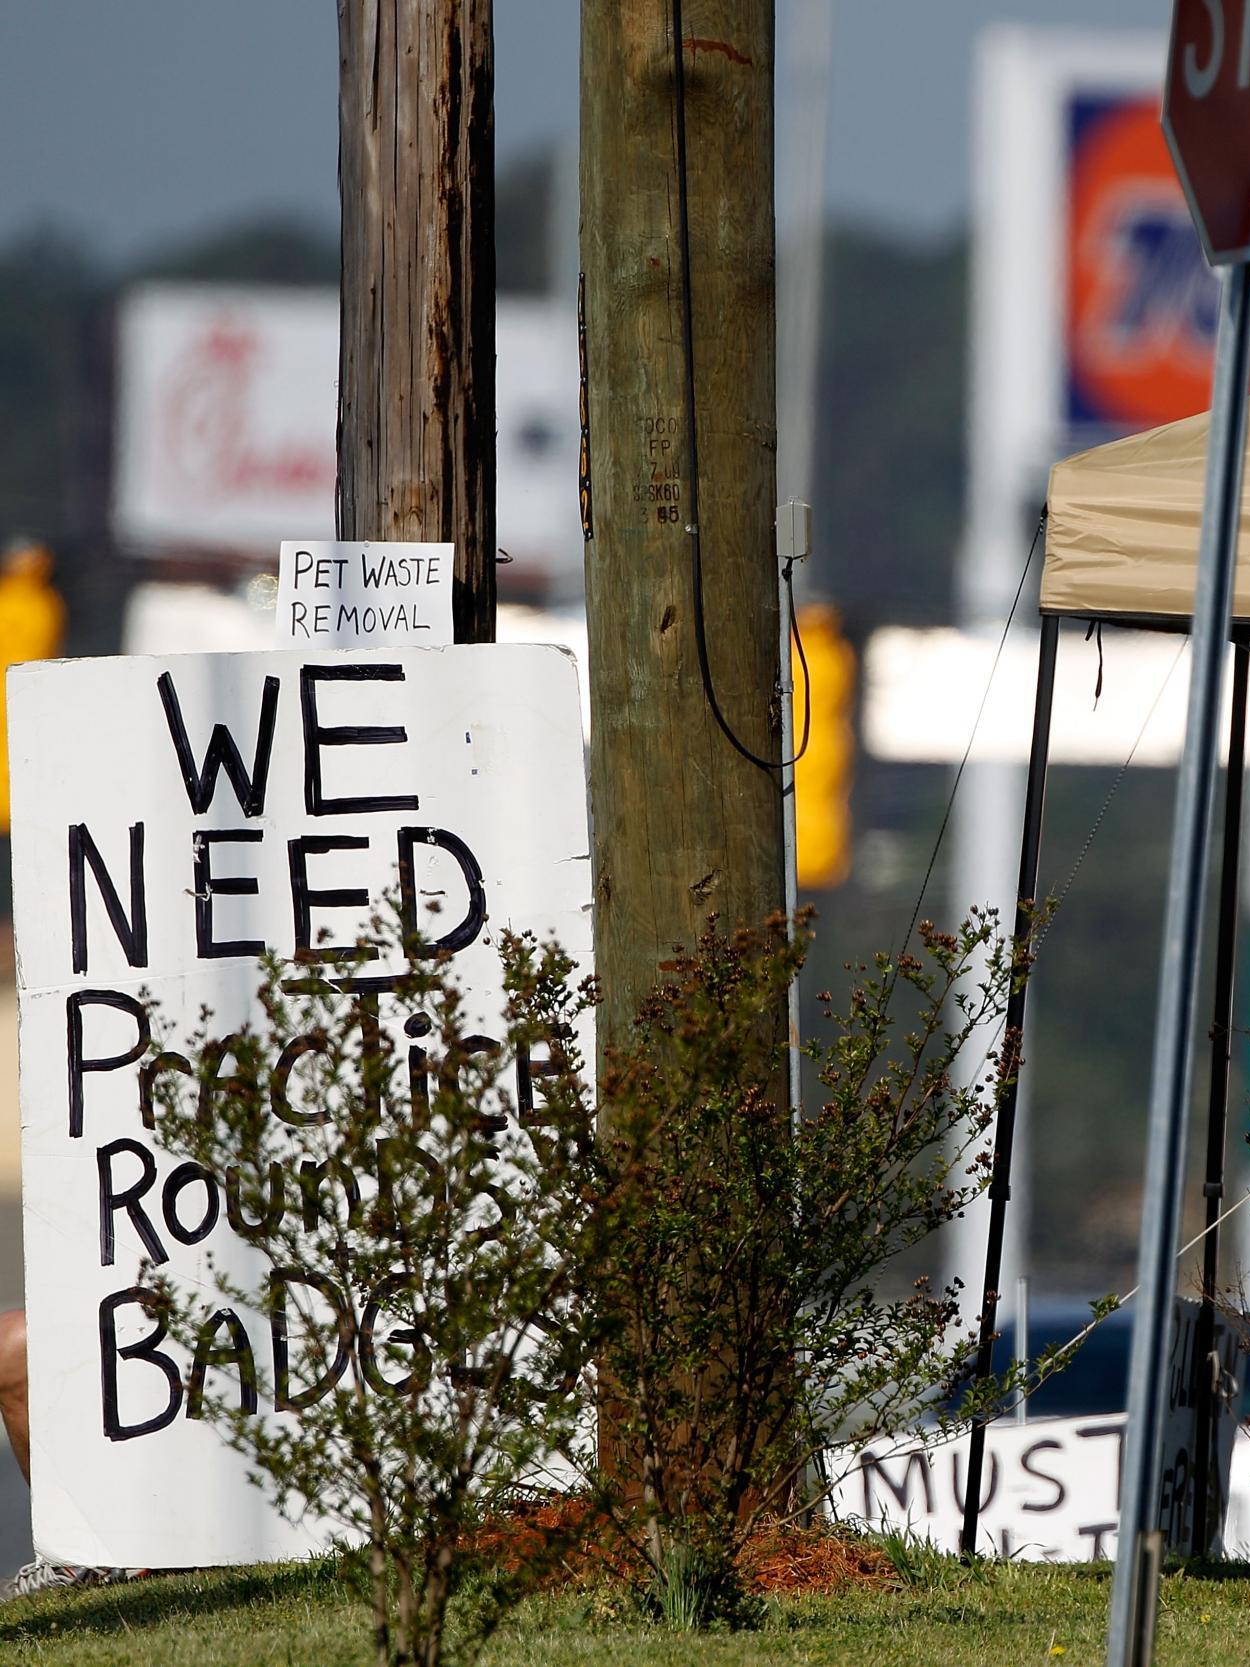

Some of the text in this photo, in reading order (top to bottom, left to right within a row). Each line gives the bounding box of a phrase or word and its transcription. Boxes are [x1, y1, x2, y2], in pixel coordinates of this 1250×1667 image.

[294, 551, 440, 589] PET WASTE
[291, 601, 431, 639] REMOVAL
[157, 664, 419, 817] WE
[69, 821, 487, 975] NEED
